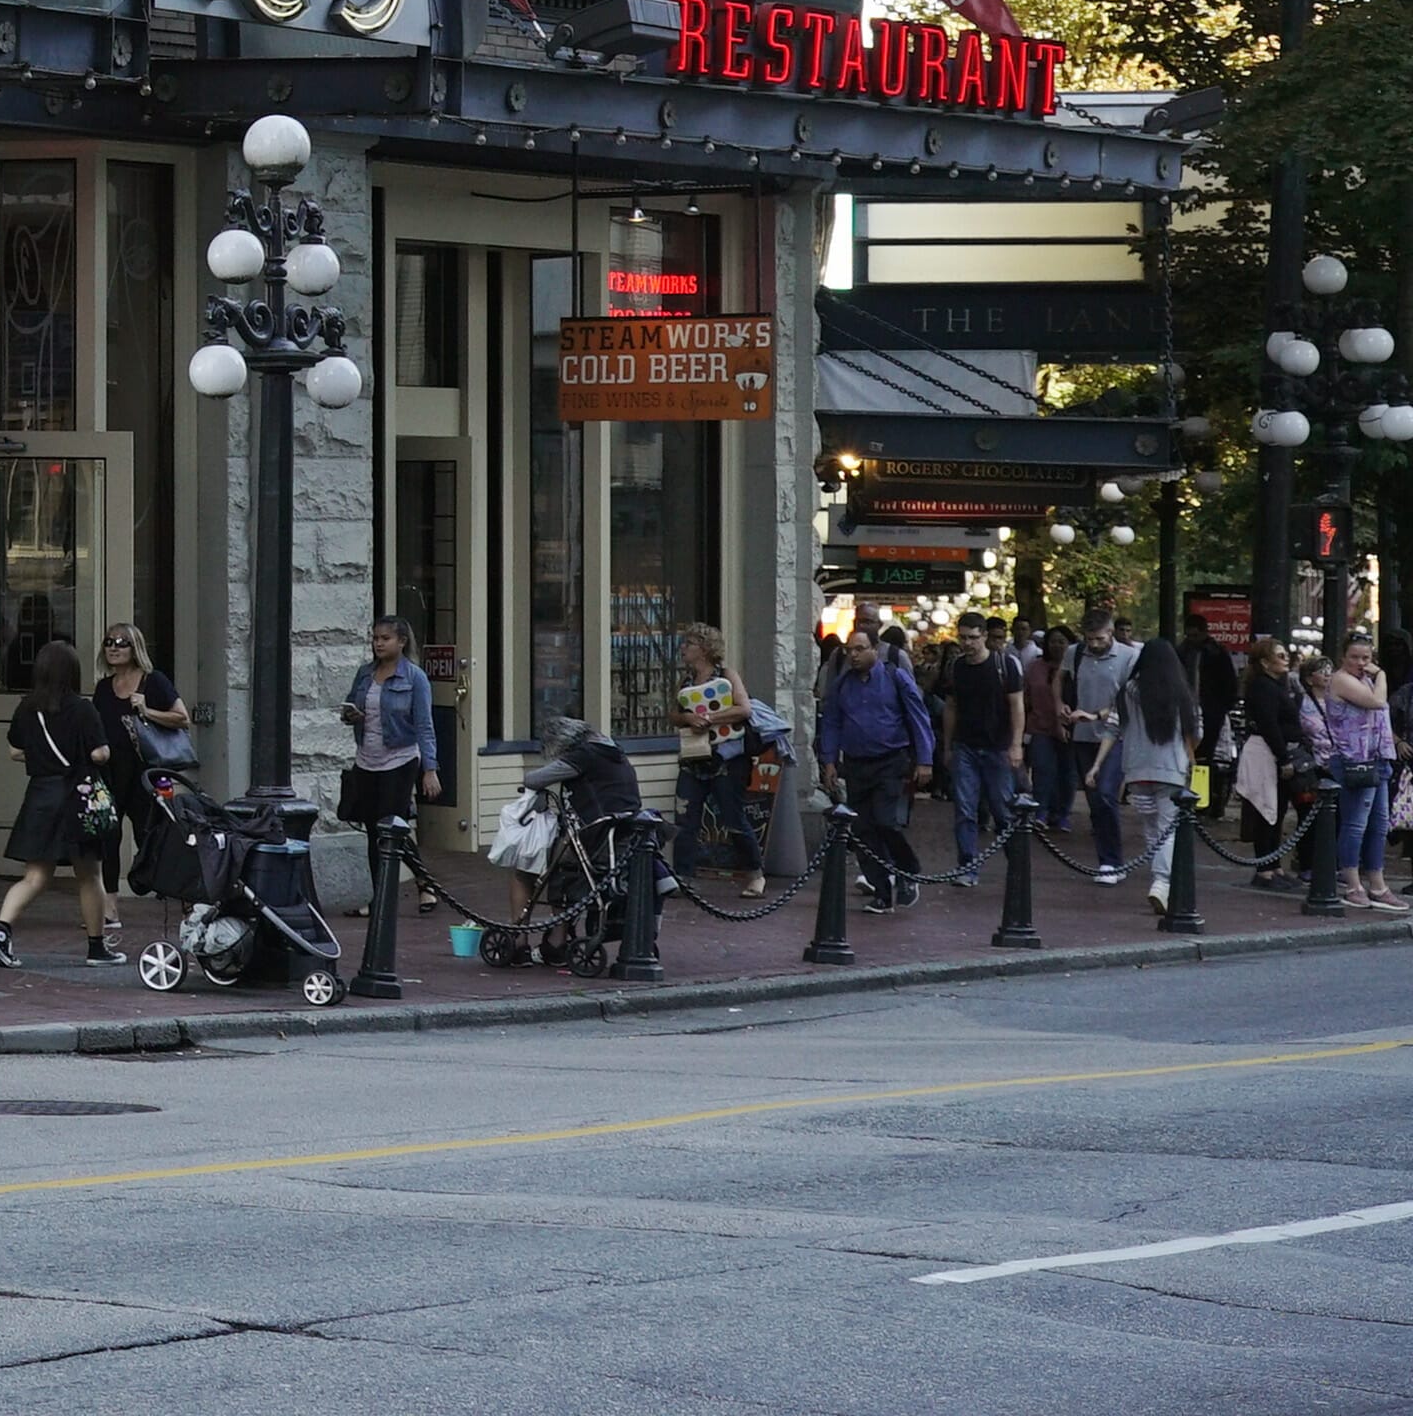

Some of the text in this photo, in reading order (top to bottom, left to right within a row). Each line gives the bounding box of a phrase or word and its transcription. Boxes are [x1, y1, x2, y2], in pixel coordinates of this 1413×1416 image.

[910, 308, 1003, 332] THE
[561, 322, 771, 351] STEAMWORKS
[562, 353, 728, 384] COLD BEER
[561, 392, 600, 408] FINE
[606, 392, 661, 408] WINES
[961, 463, 1076, 481] CHOCOLATES
[878, 567, 925, 583] JADE
[1206, 621, 1231, 631] anks
[425, 659, 453, 676] OPEN
